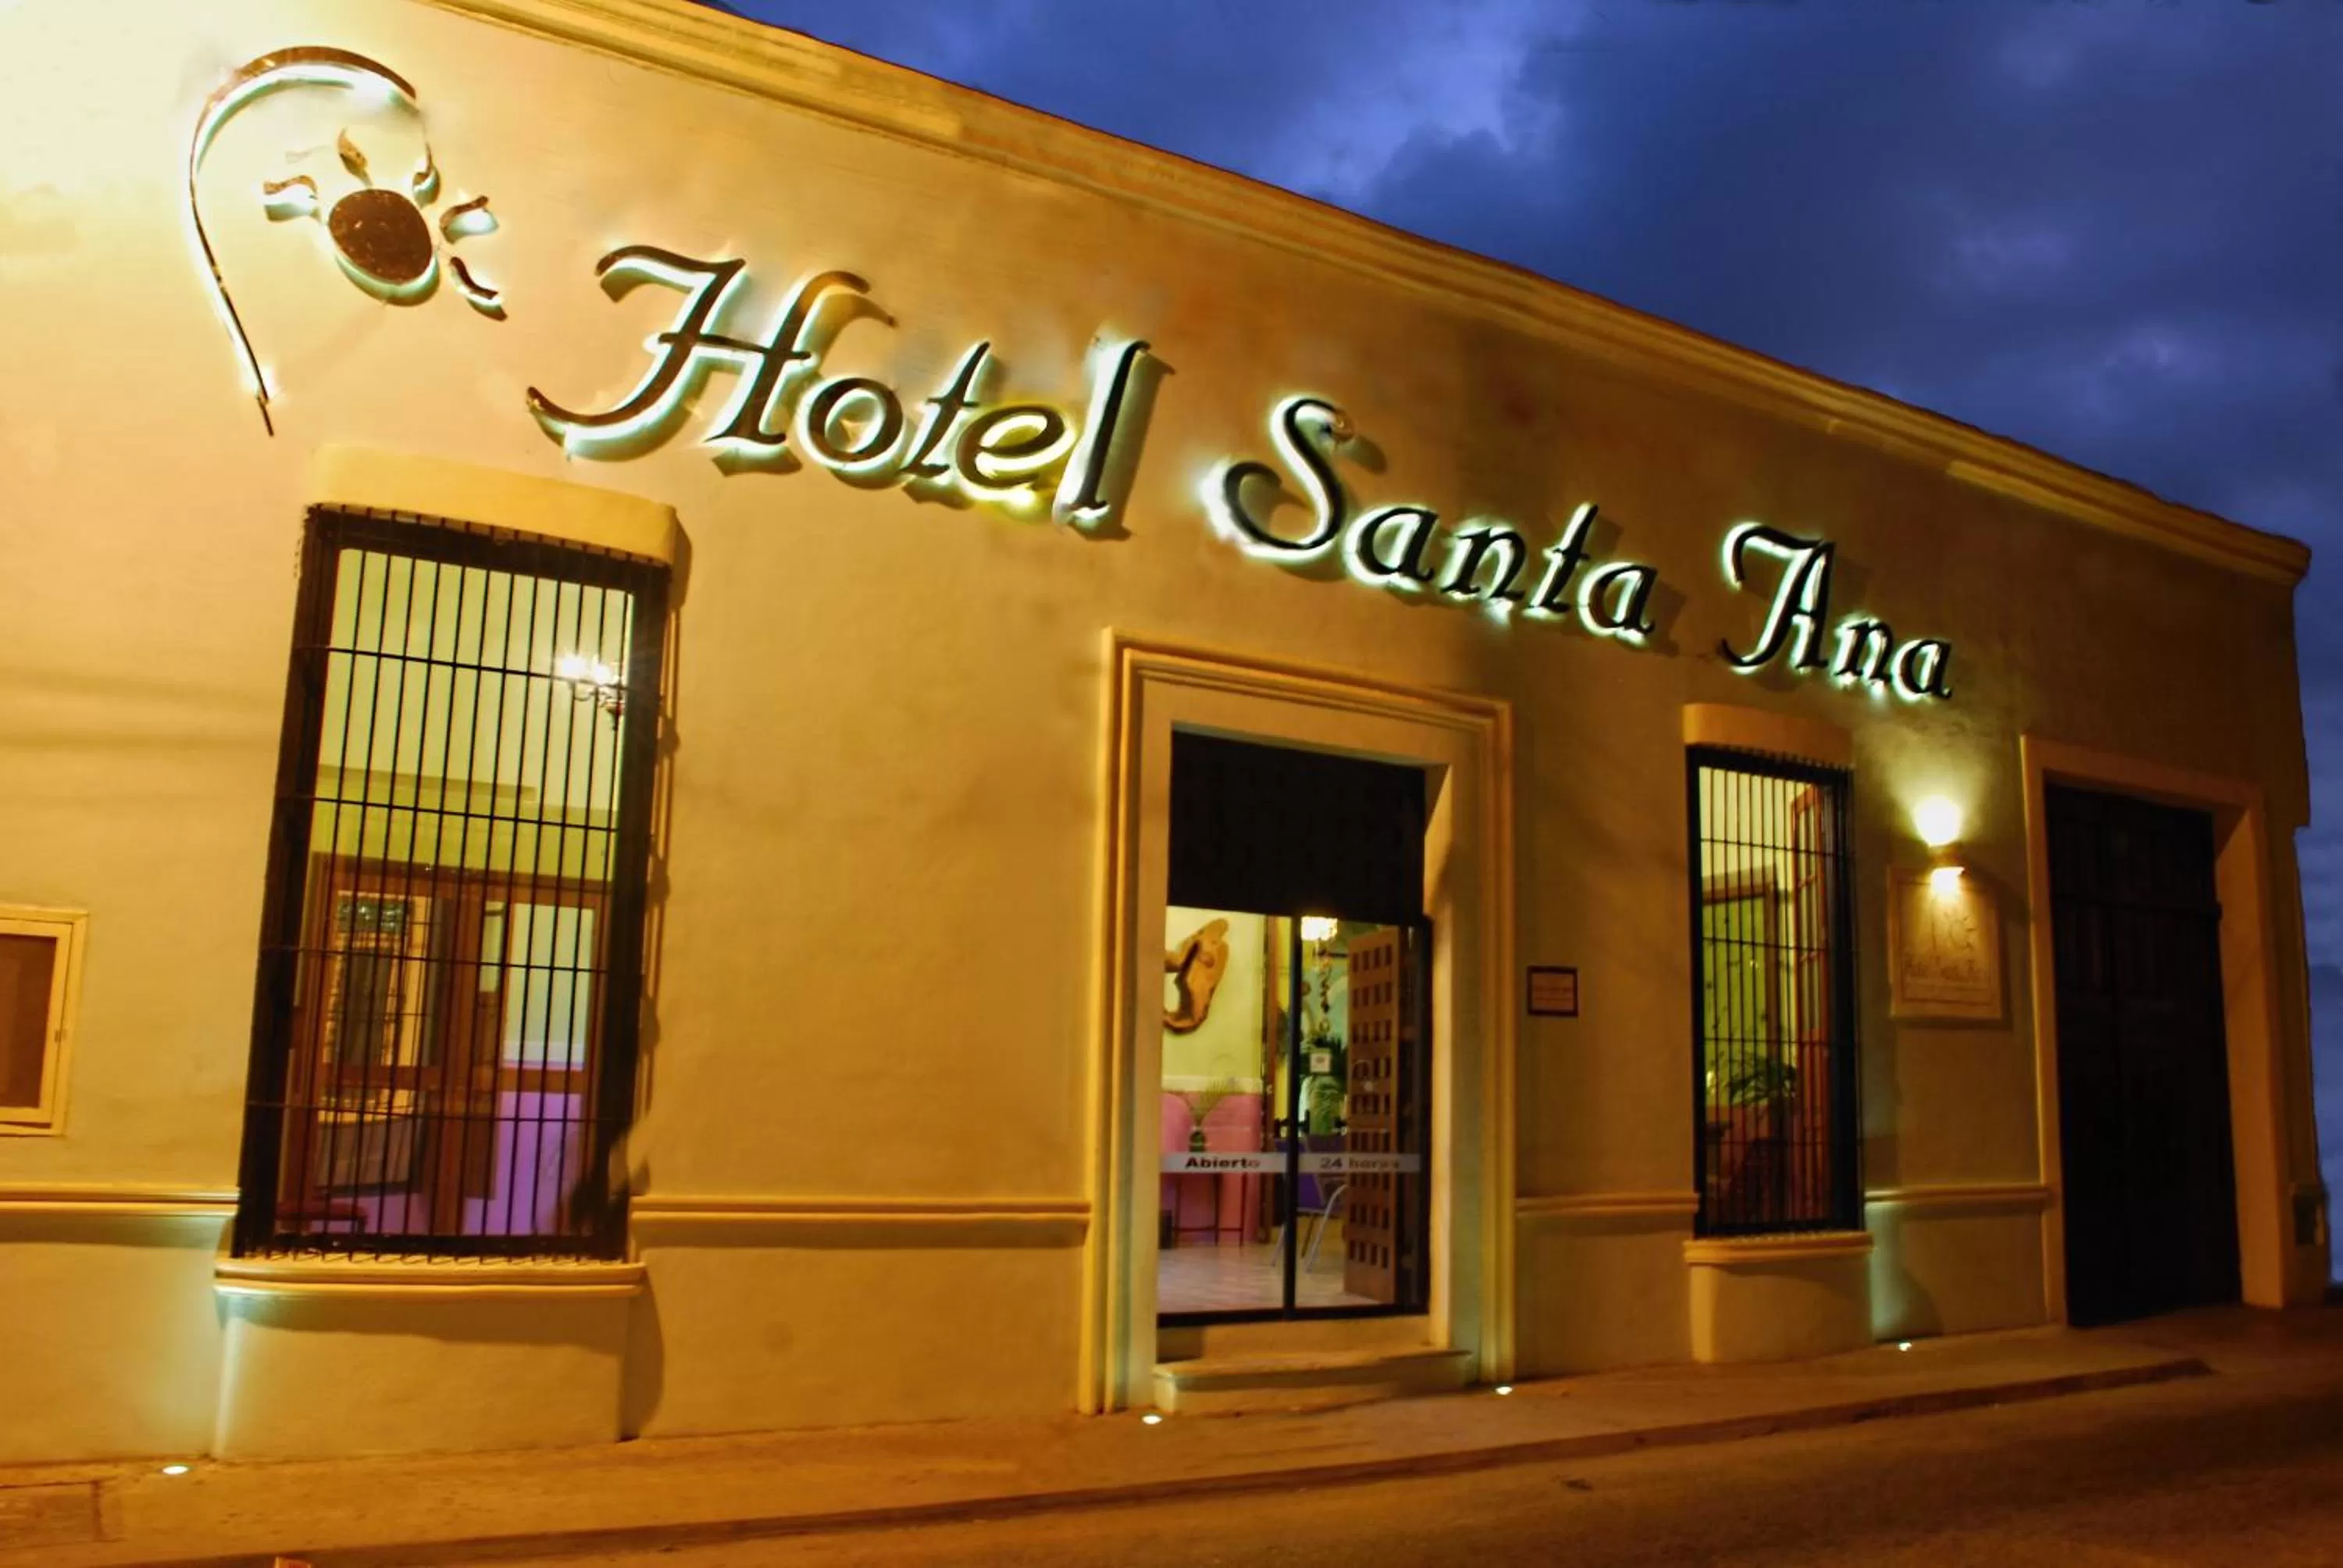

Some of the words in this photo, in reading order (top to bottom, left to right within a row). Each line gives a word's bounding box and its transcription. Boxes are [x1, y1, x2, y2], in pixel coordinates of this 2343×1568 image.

[526, 244, 1153, 515] Hotel
[1217, 395, 1659, 643] Santa
[1720, 522, 1954, 700] Ana
[1185, 1155, 1262, 1170] Abierto
[1320, 1156, 1343, 1170] 24
